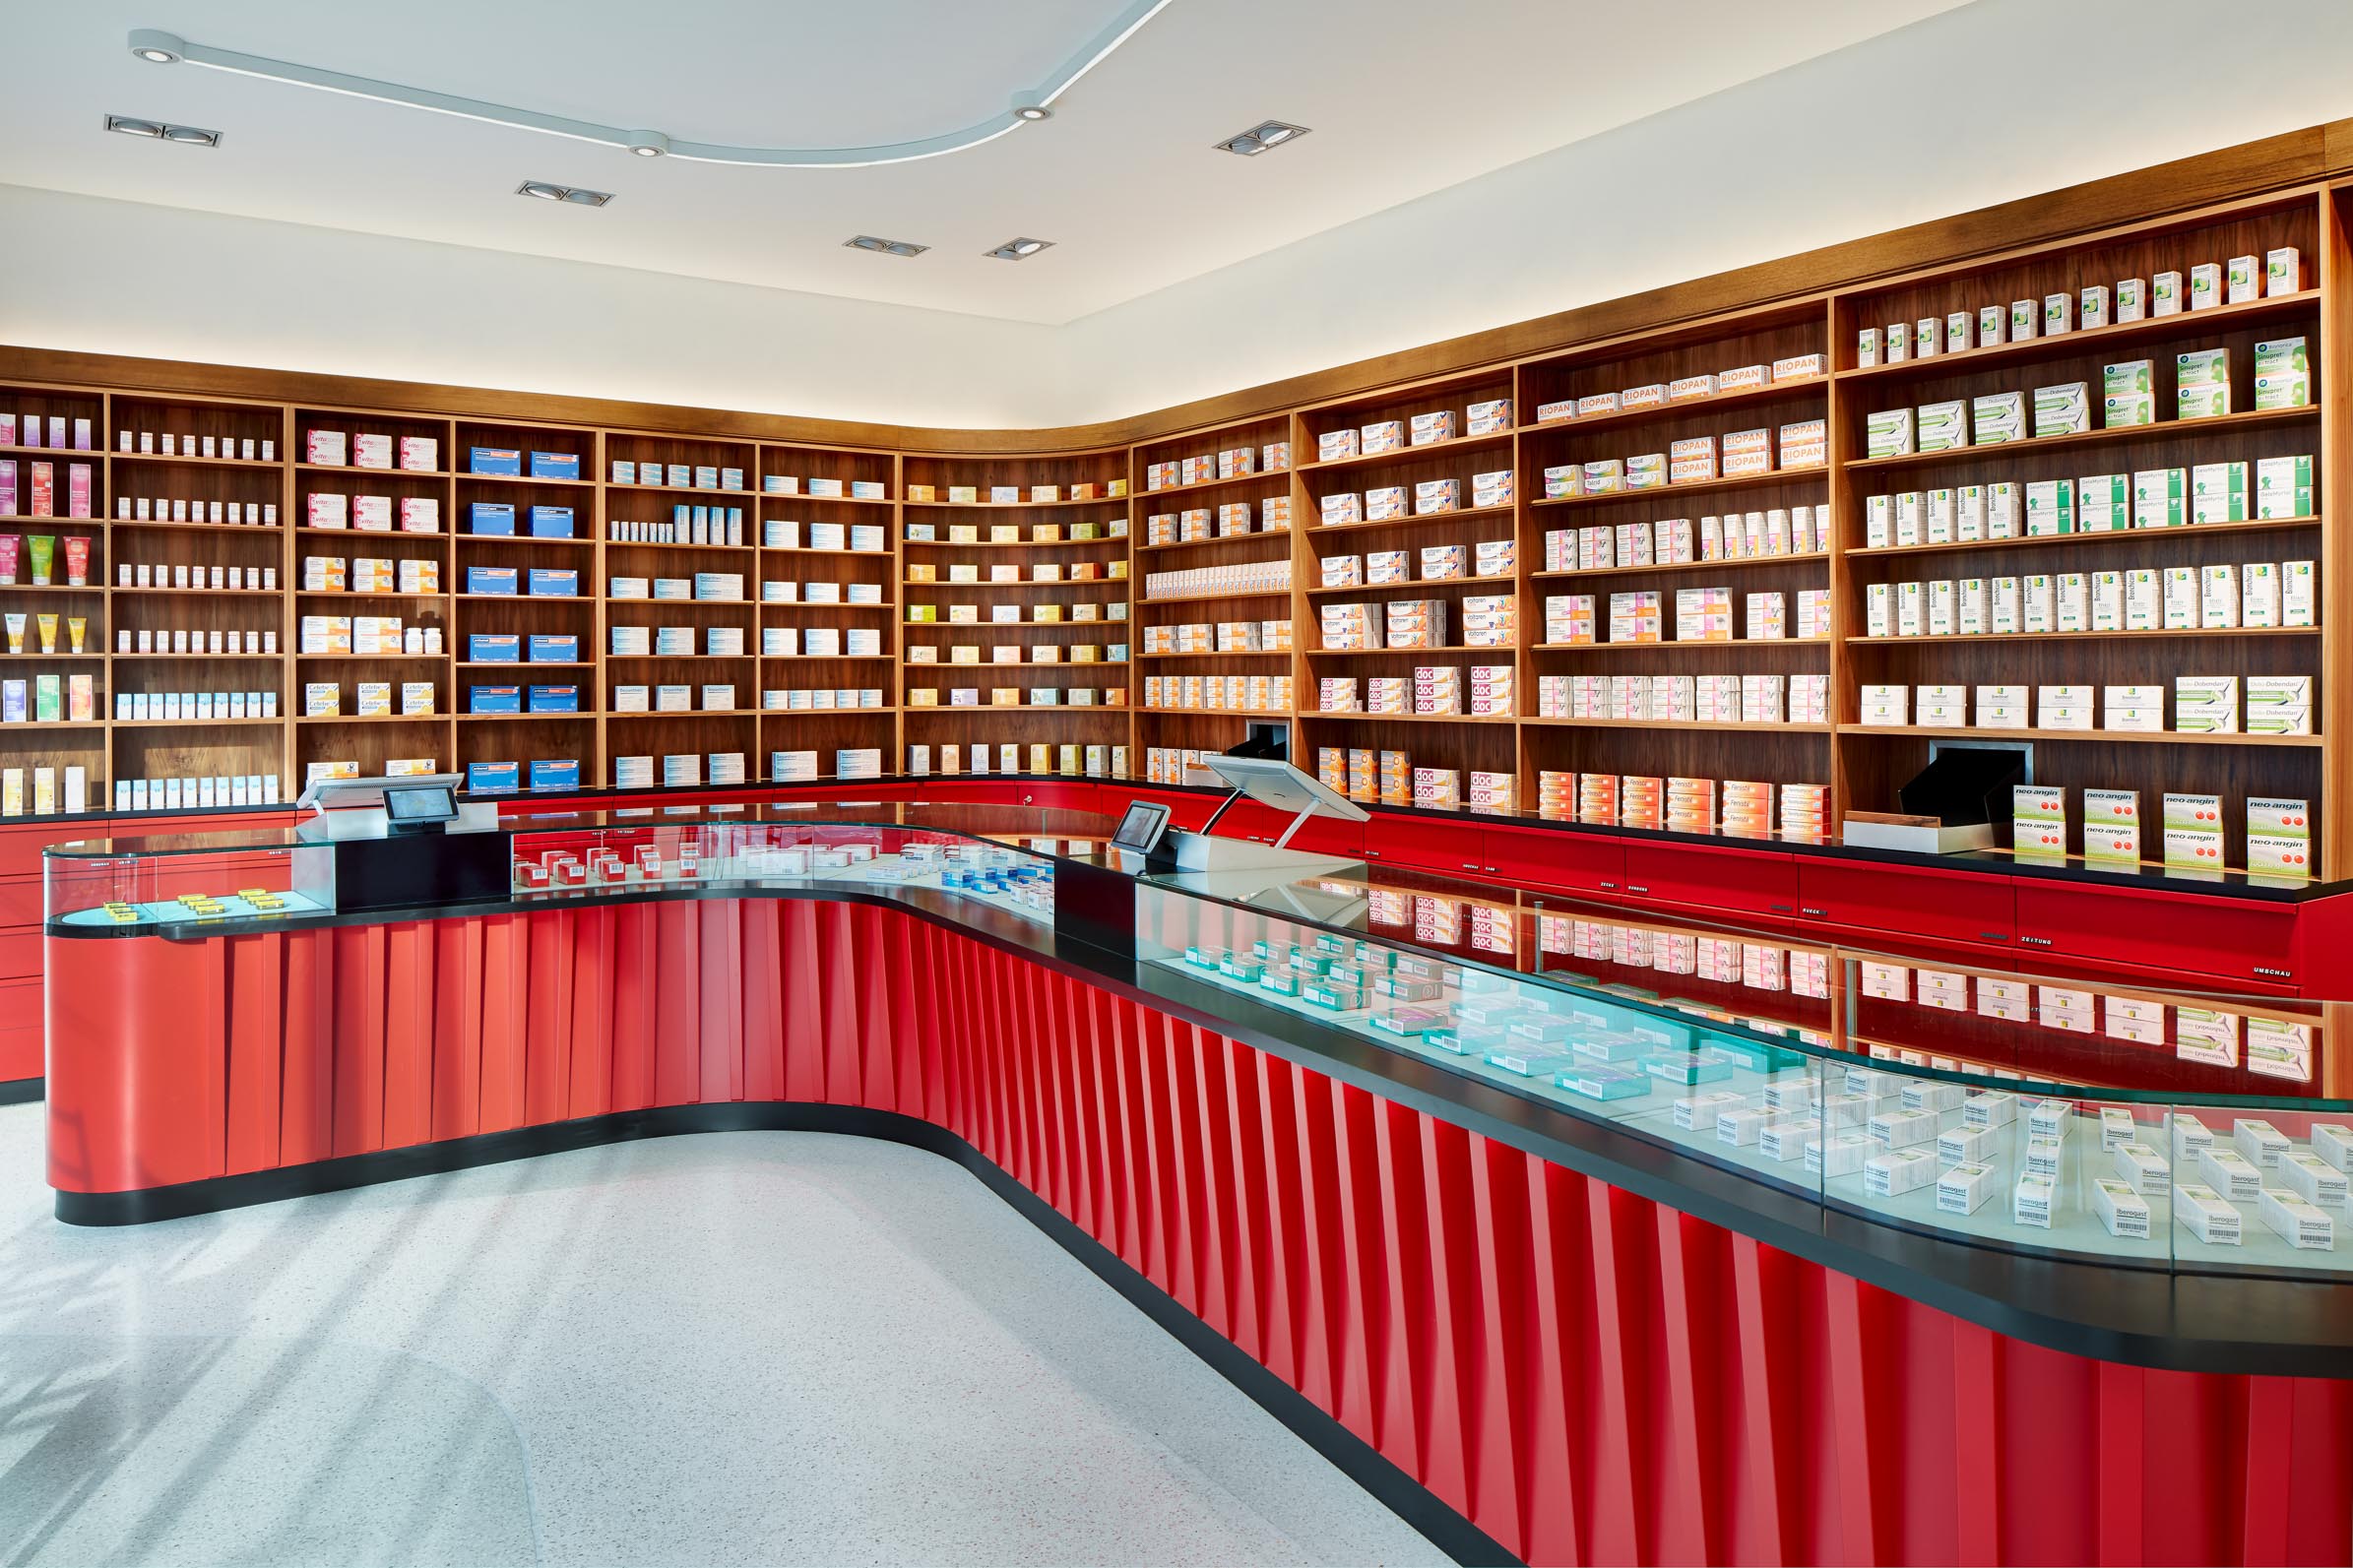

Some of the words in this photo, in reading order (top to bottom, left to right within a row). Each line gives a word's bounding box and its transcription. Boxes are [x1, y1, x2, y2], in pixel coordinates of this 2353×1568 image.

[1775, 357, 1816, 374] RIOPAN
[1721, 368, 1759, 384] RIOPAN
[1672, 378, 1707, 393] RIOPAN
[1624, 388, 1659, 402] RIOPAN
[1580, 396, 1613, 409] RIOPAN
[1540, 403, 1570, 416] RIOPAN
[1783, 422, 1821, 439] RIOPAN
[1725, 431, 1763, 448] RIOPAN
[1674, 440, 1708, 454] RIOPAN
[1783, 446, 1821, 463] RIOPAN
[1725, 454, 1763, 470] RIOPAN
[1673, 462, 1708, 475] RIOPAN
[1417, 669, 1433, 679] doc
[1472, 668, 1491, 679] doc
[1417, 684, 1433, 695] doc
[1472, 684, 1491, 695] doc
[1417, 700, 1433, 710] doc
[1472, 700, 1491, 712] doc
[1416, 770, 1433, 781] doc
[1472, 773, 1491, 784] doc
[1416, 785, 1433, 796] doc
[1472, 789, 1491, 801] doc
[2272, 840, 2303, 848] angin
[2021, 936, 2052, 945] ZEITUNG
[2254, 967, 2291, 976] UMSCHAU
[2106, 1128, 2133, 1138] Iberogast
[2261, 1142, 2290, 1151] Iberogast
[2142, 1168, 2171, 1177] Iberogas
[2231, 1174, 2259, 1183] Iberogast
[2318, 1179, 2347, 1189] Iberogast
[2116, 1208, 2147, 1219] Iberogast
[2208, 1215, 2239, 1225] Iberogast
[2299, 1221, 2330, 1230] Iberogast
